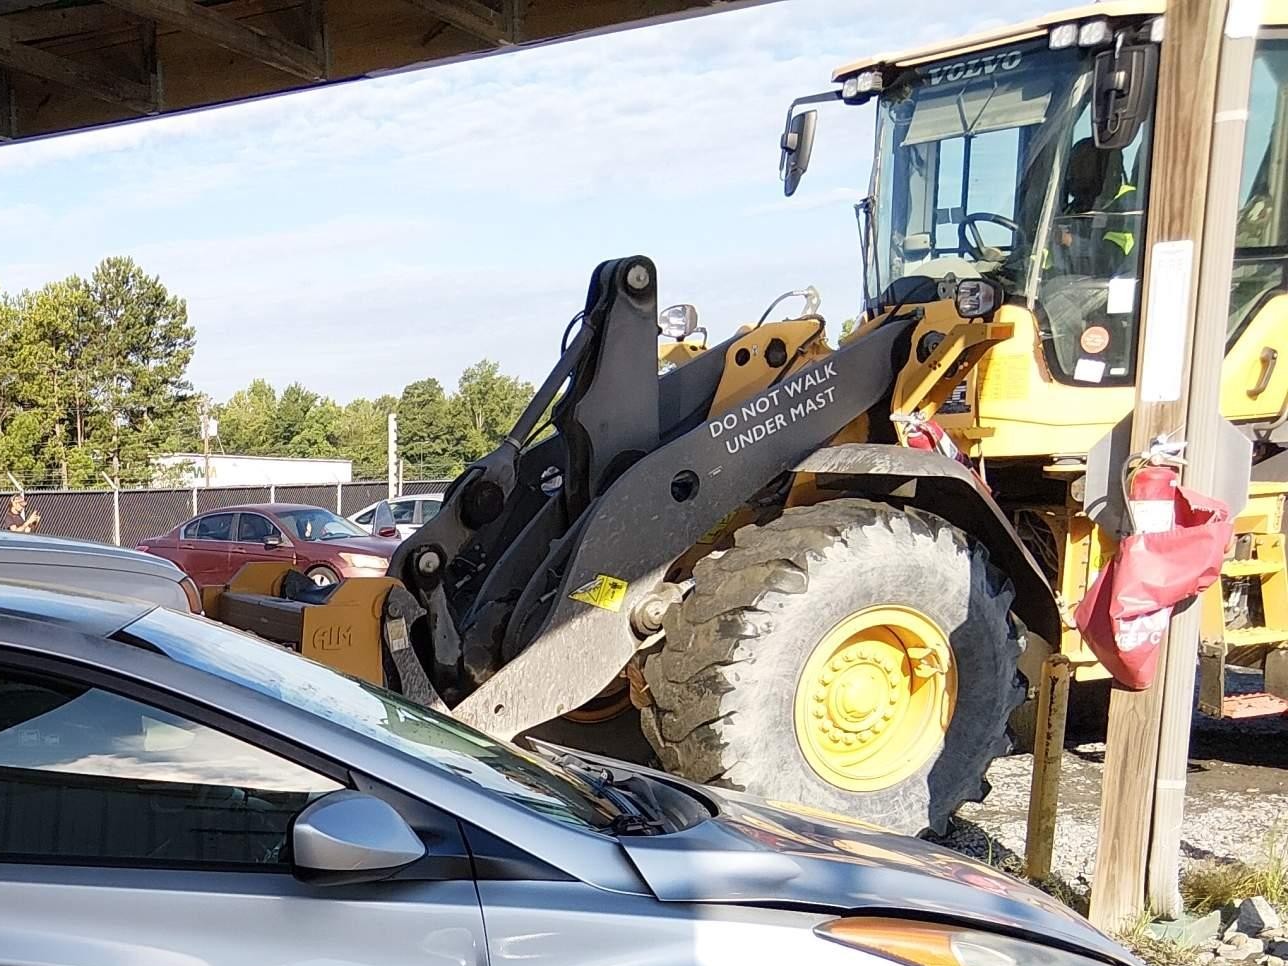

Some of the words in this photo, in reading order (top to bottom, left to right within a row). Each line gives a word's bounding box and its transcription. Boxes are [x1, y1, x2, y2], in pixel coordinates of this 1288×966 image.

[928, 50, 1022, 86] VOLVO
[709, 413, 738, 438] DO
[741, 389, 780, 422] NOT
[784, 362, 838, 398] WALK
[725, 413, 788, 454] UNDER
[790, 386, 835, 422] MAST
